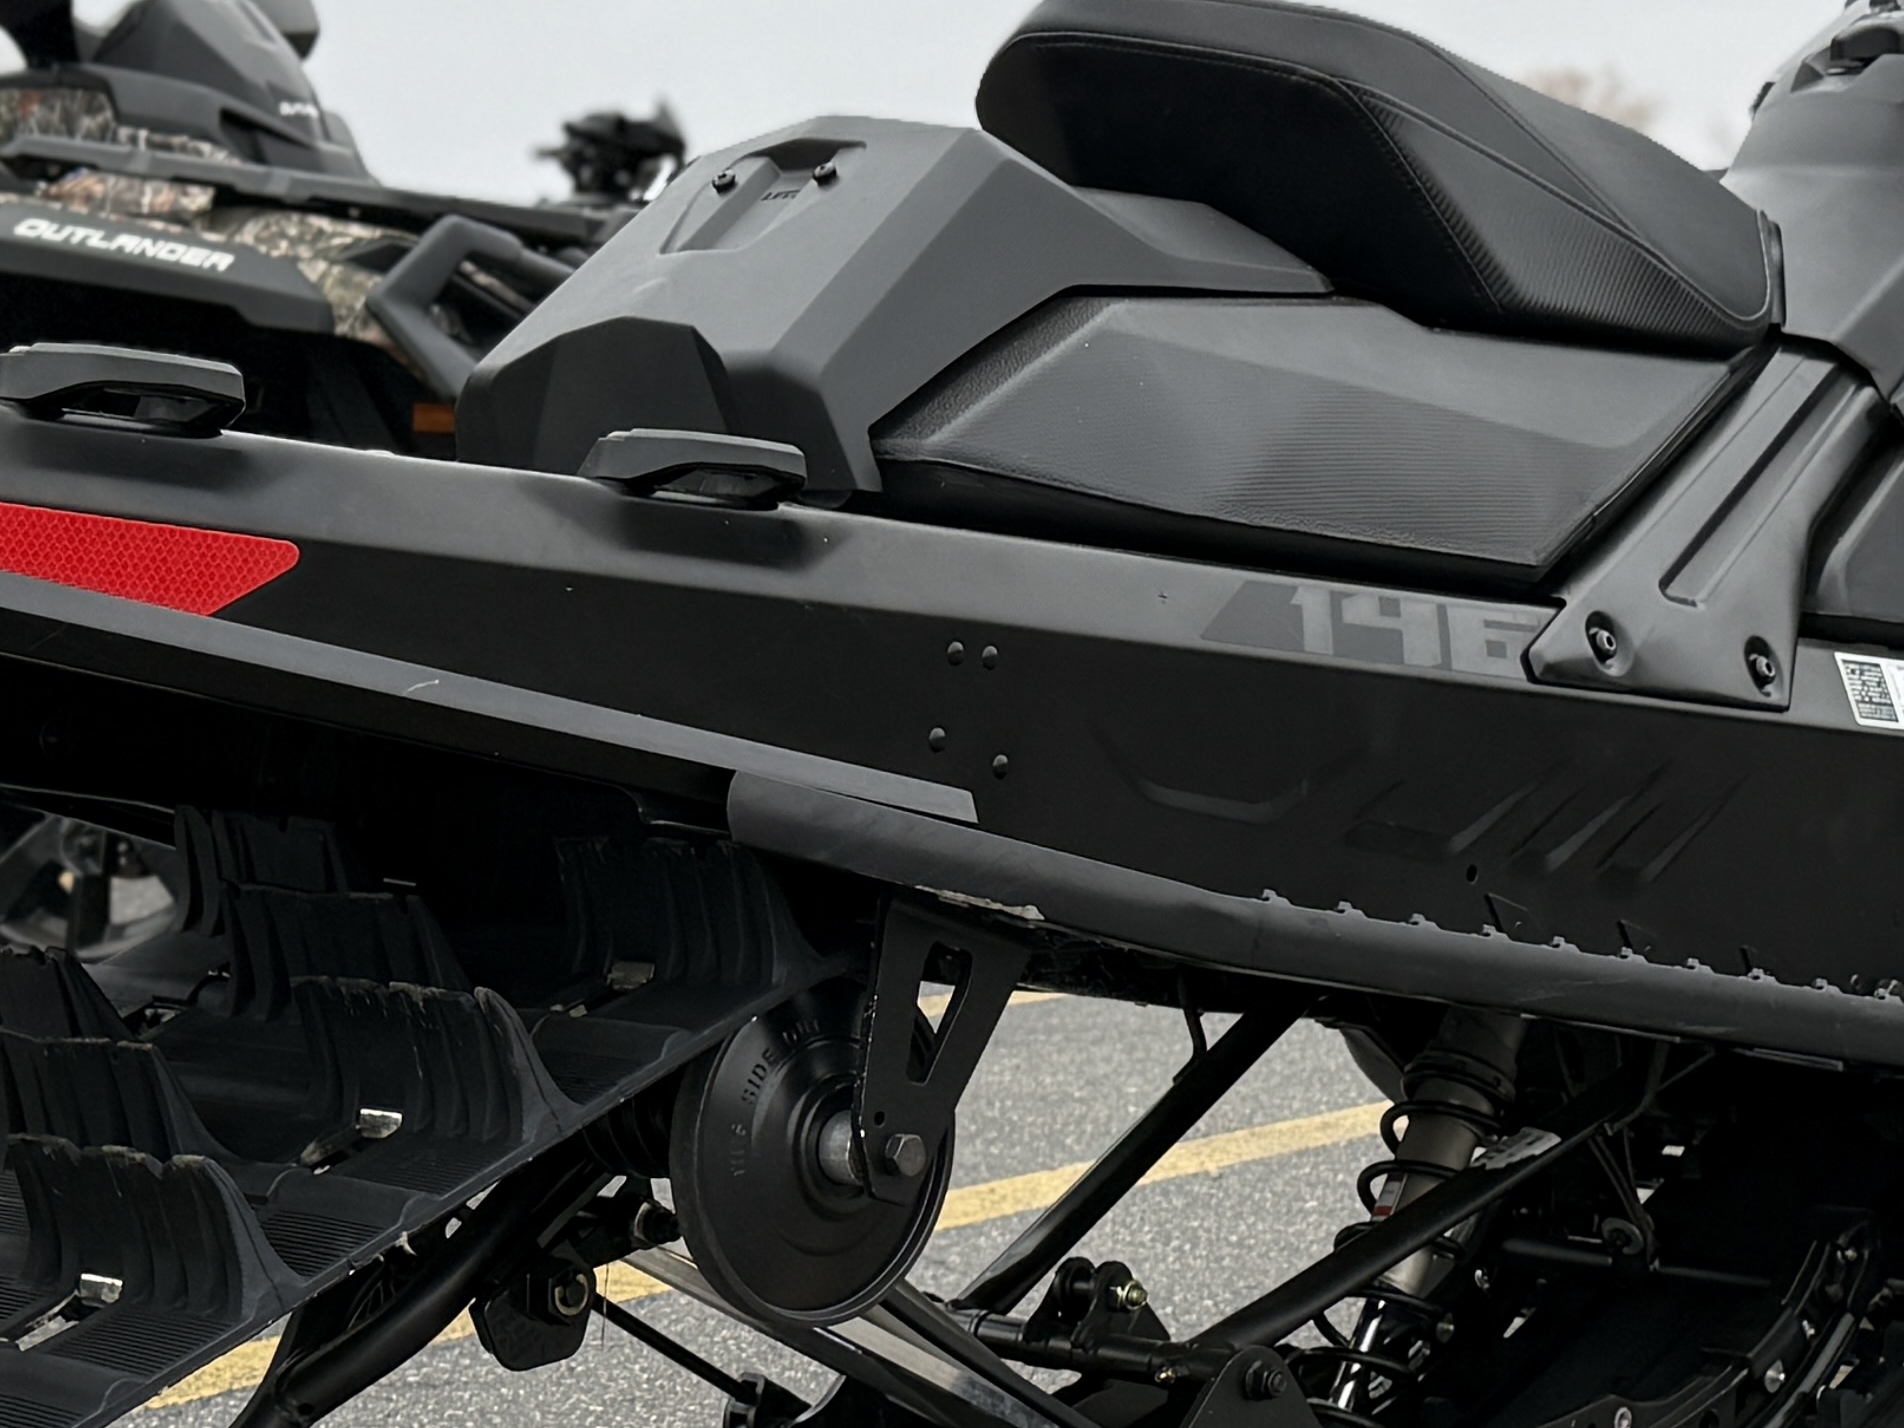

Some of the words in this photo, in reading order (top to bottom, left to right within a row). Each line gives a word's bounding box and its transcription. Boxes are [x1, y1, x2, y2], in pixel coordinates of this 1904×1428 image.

[13, 218, 235, 272] OUTLANDER
[1290, 584, 1558, 681] 146
[741, 1046, 777, 1106] SIDE
